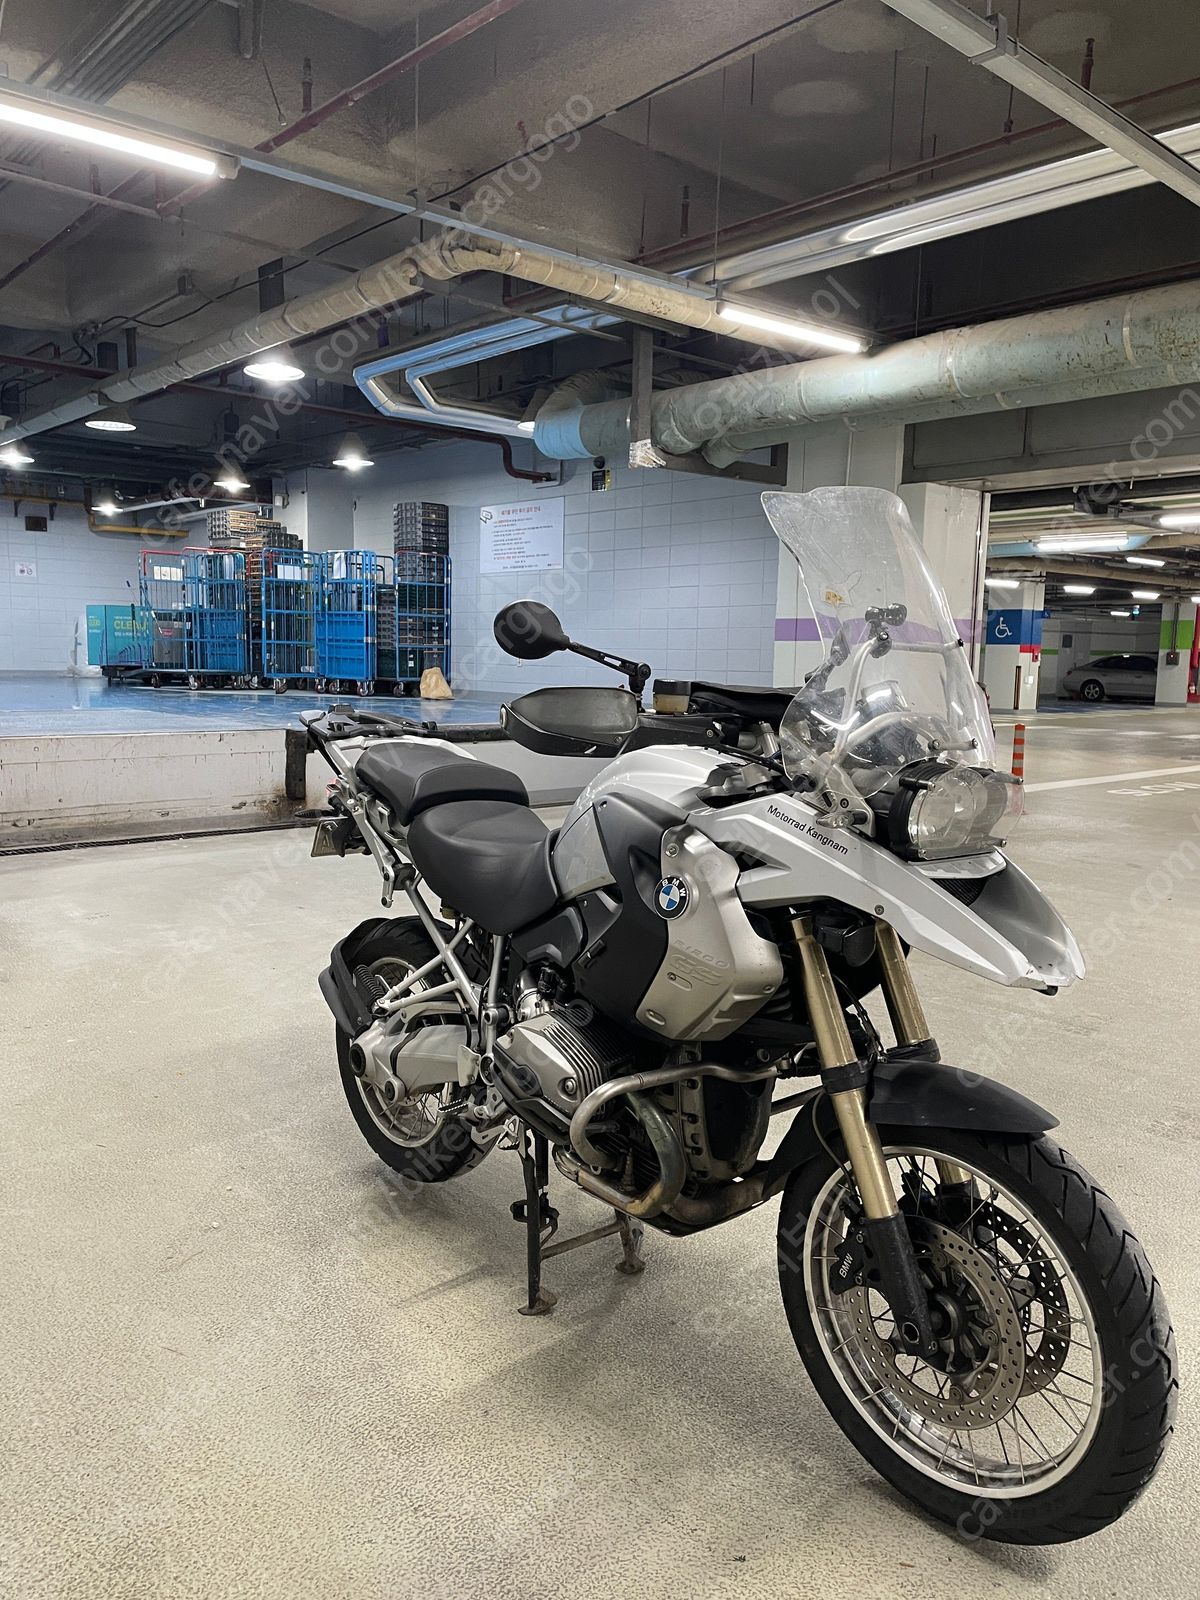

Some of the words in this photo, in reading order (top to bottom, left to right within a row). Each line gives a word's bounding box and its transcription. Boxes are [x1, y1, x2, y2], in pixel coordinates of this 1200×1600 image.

[767, 804, 807, 832] Motorrad
[806, 826, 849, 855] Kangnam
[839, 1253, 854, 1278] BMW
